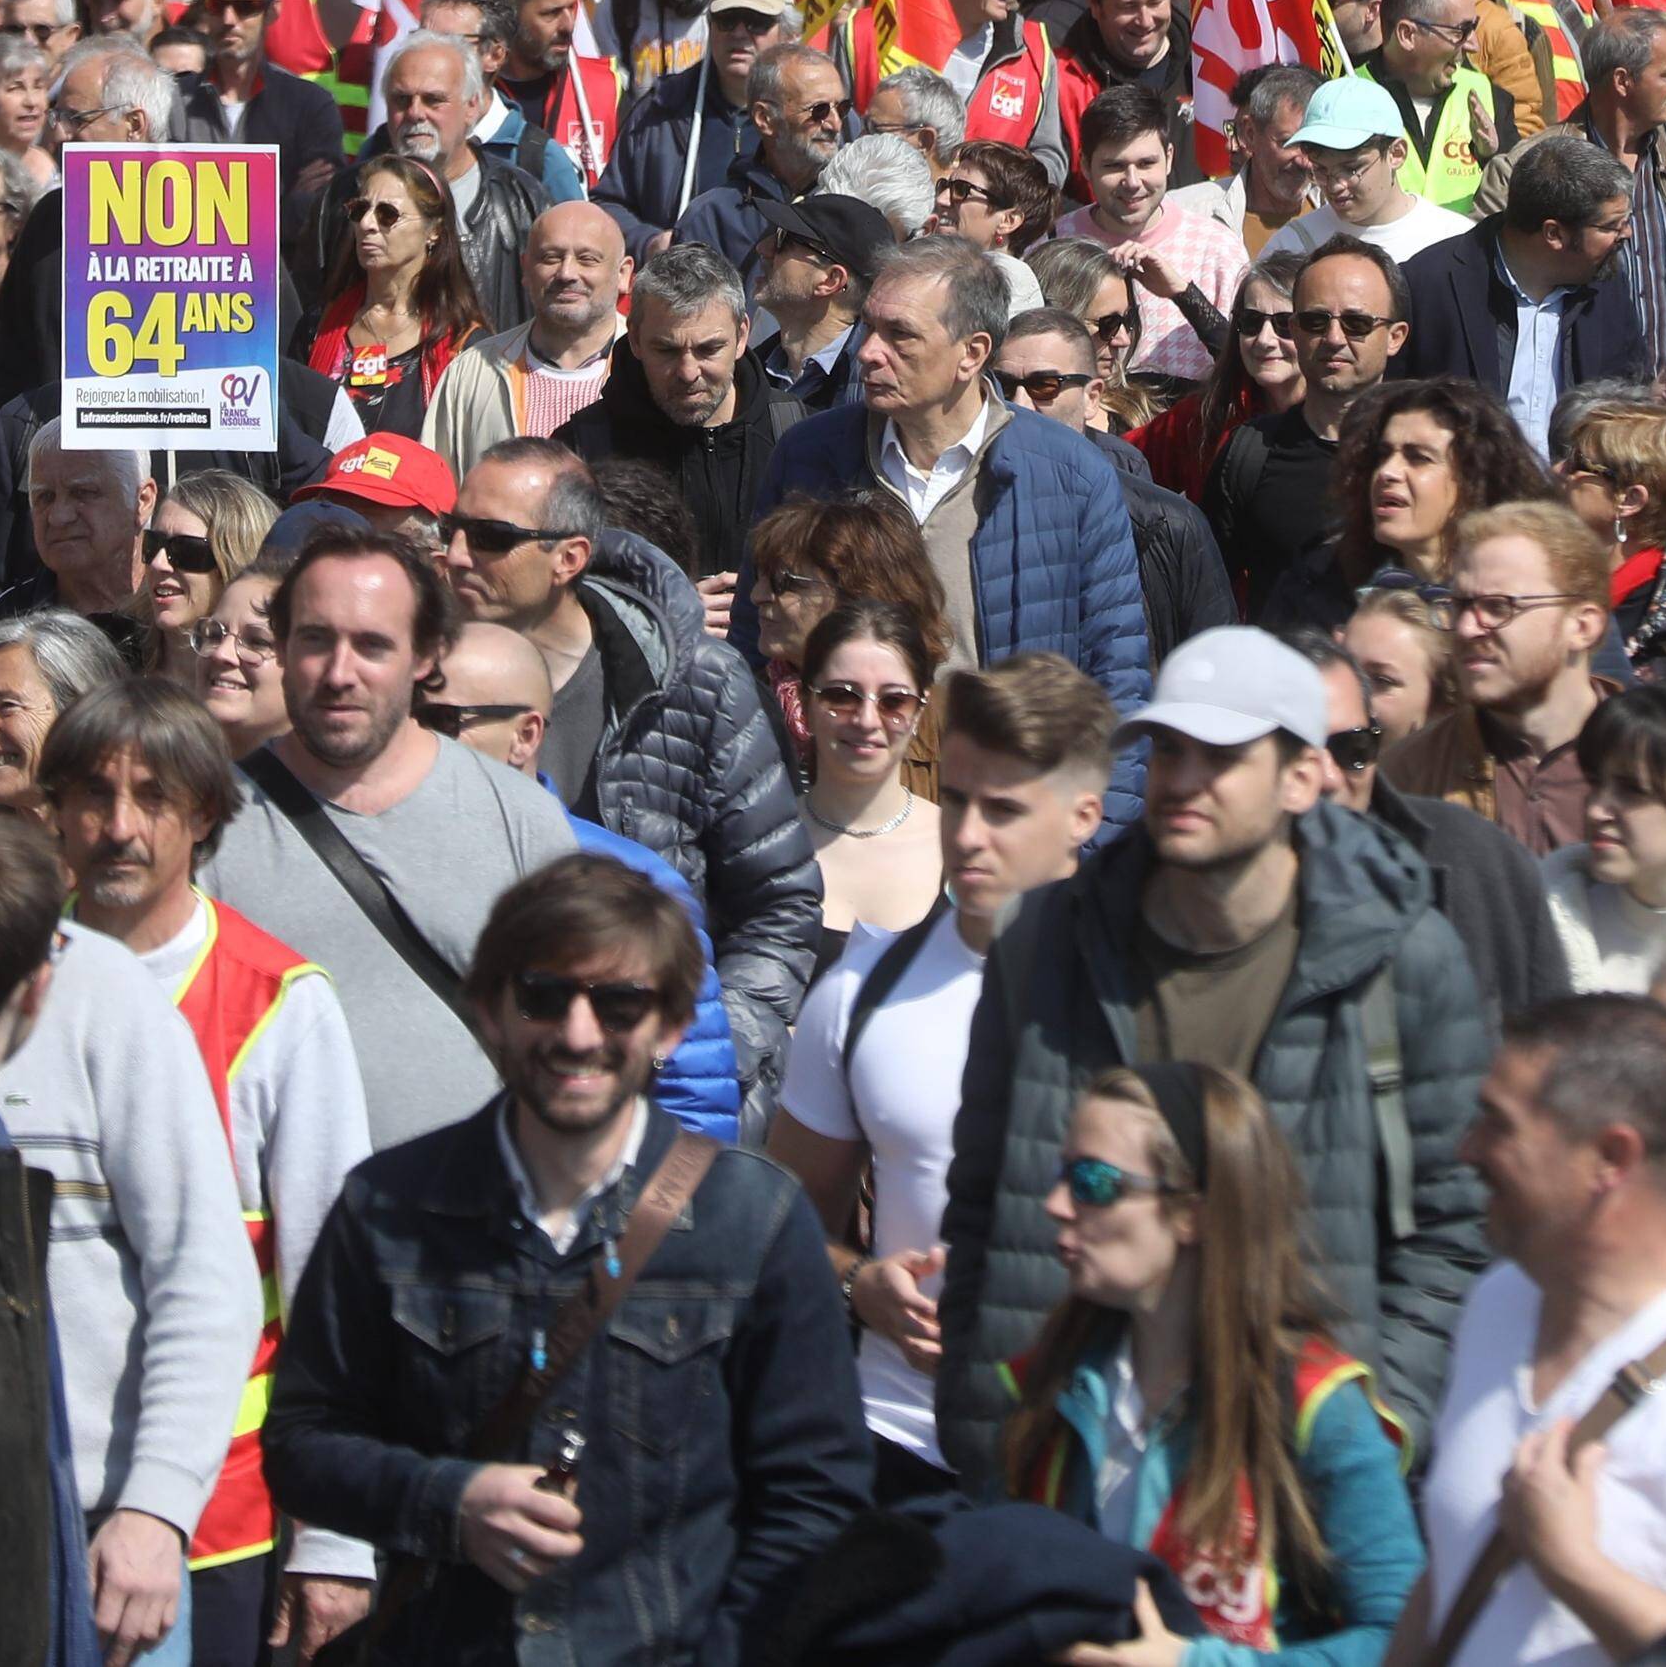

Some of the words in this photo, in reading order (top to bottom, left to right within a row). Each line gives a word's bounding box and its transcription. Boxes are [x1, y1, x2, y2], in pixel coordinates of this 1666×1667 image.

[991, 94, 1024, 117] cgt
[87, 158, 251, 246] NON
[86, 251, 103, 283] À
[104, 255, 131, 283] LA
[134, 255, 234, 283] RETRAITE
[237, 252, 254, 283] À
[86, 289, 186, 378] 64
[181, 291, 255, 334] ANS
[352, 354, 388, 376] cgt
[76, 387, 126, 407] Rejoignez
[127, 388, 137, 404] la
[138, 387, 200, 404] mobilisation
[79, 409, 209, 427] lafranceinsoumise.fr/retraites
[219, 409, 249, 419] FRANCE
[219, 417, 262, 428] INSOUMISE
[339, 453, 366, 474] cgt
